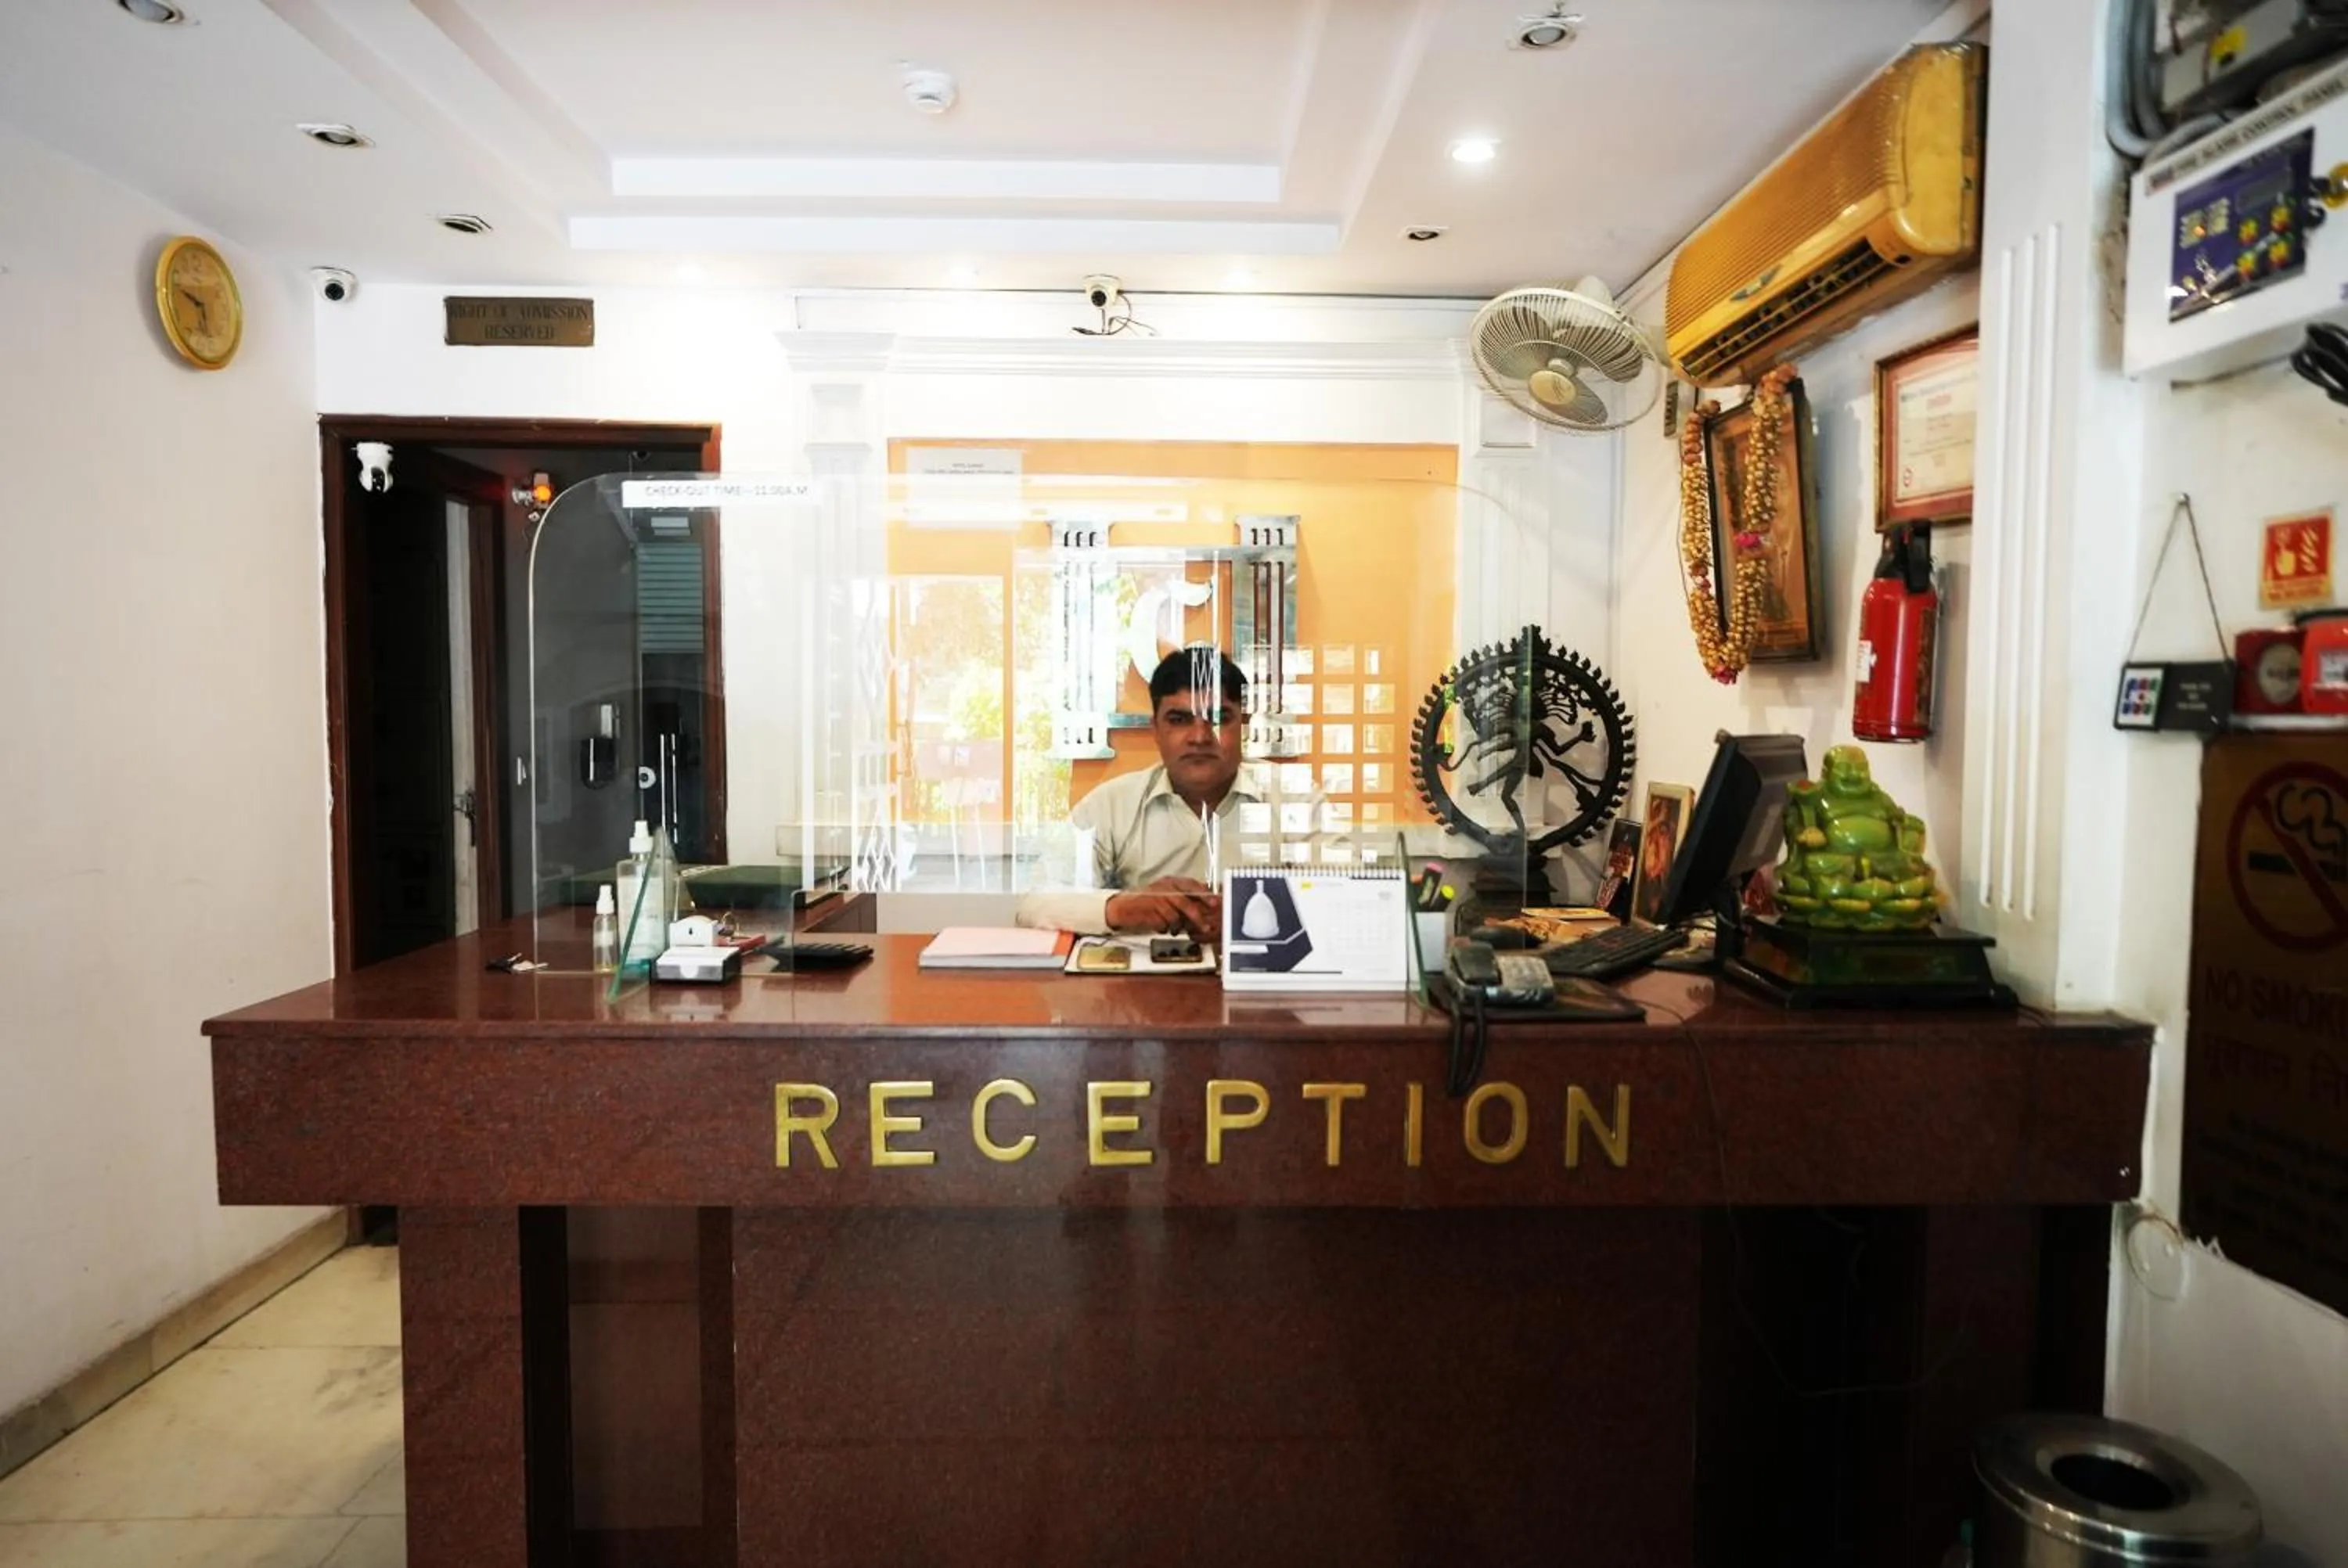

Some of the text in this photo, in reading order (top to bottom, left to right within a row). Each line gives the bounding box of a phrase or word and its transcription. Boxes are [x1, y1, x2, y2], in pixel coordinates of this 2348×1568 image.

[484, 325, 555, 340] RESERVED
[2205, 965, 2242, 1012] NO
[775, 1079, 1630, 1168] RECEPTION
